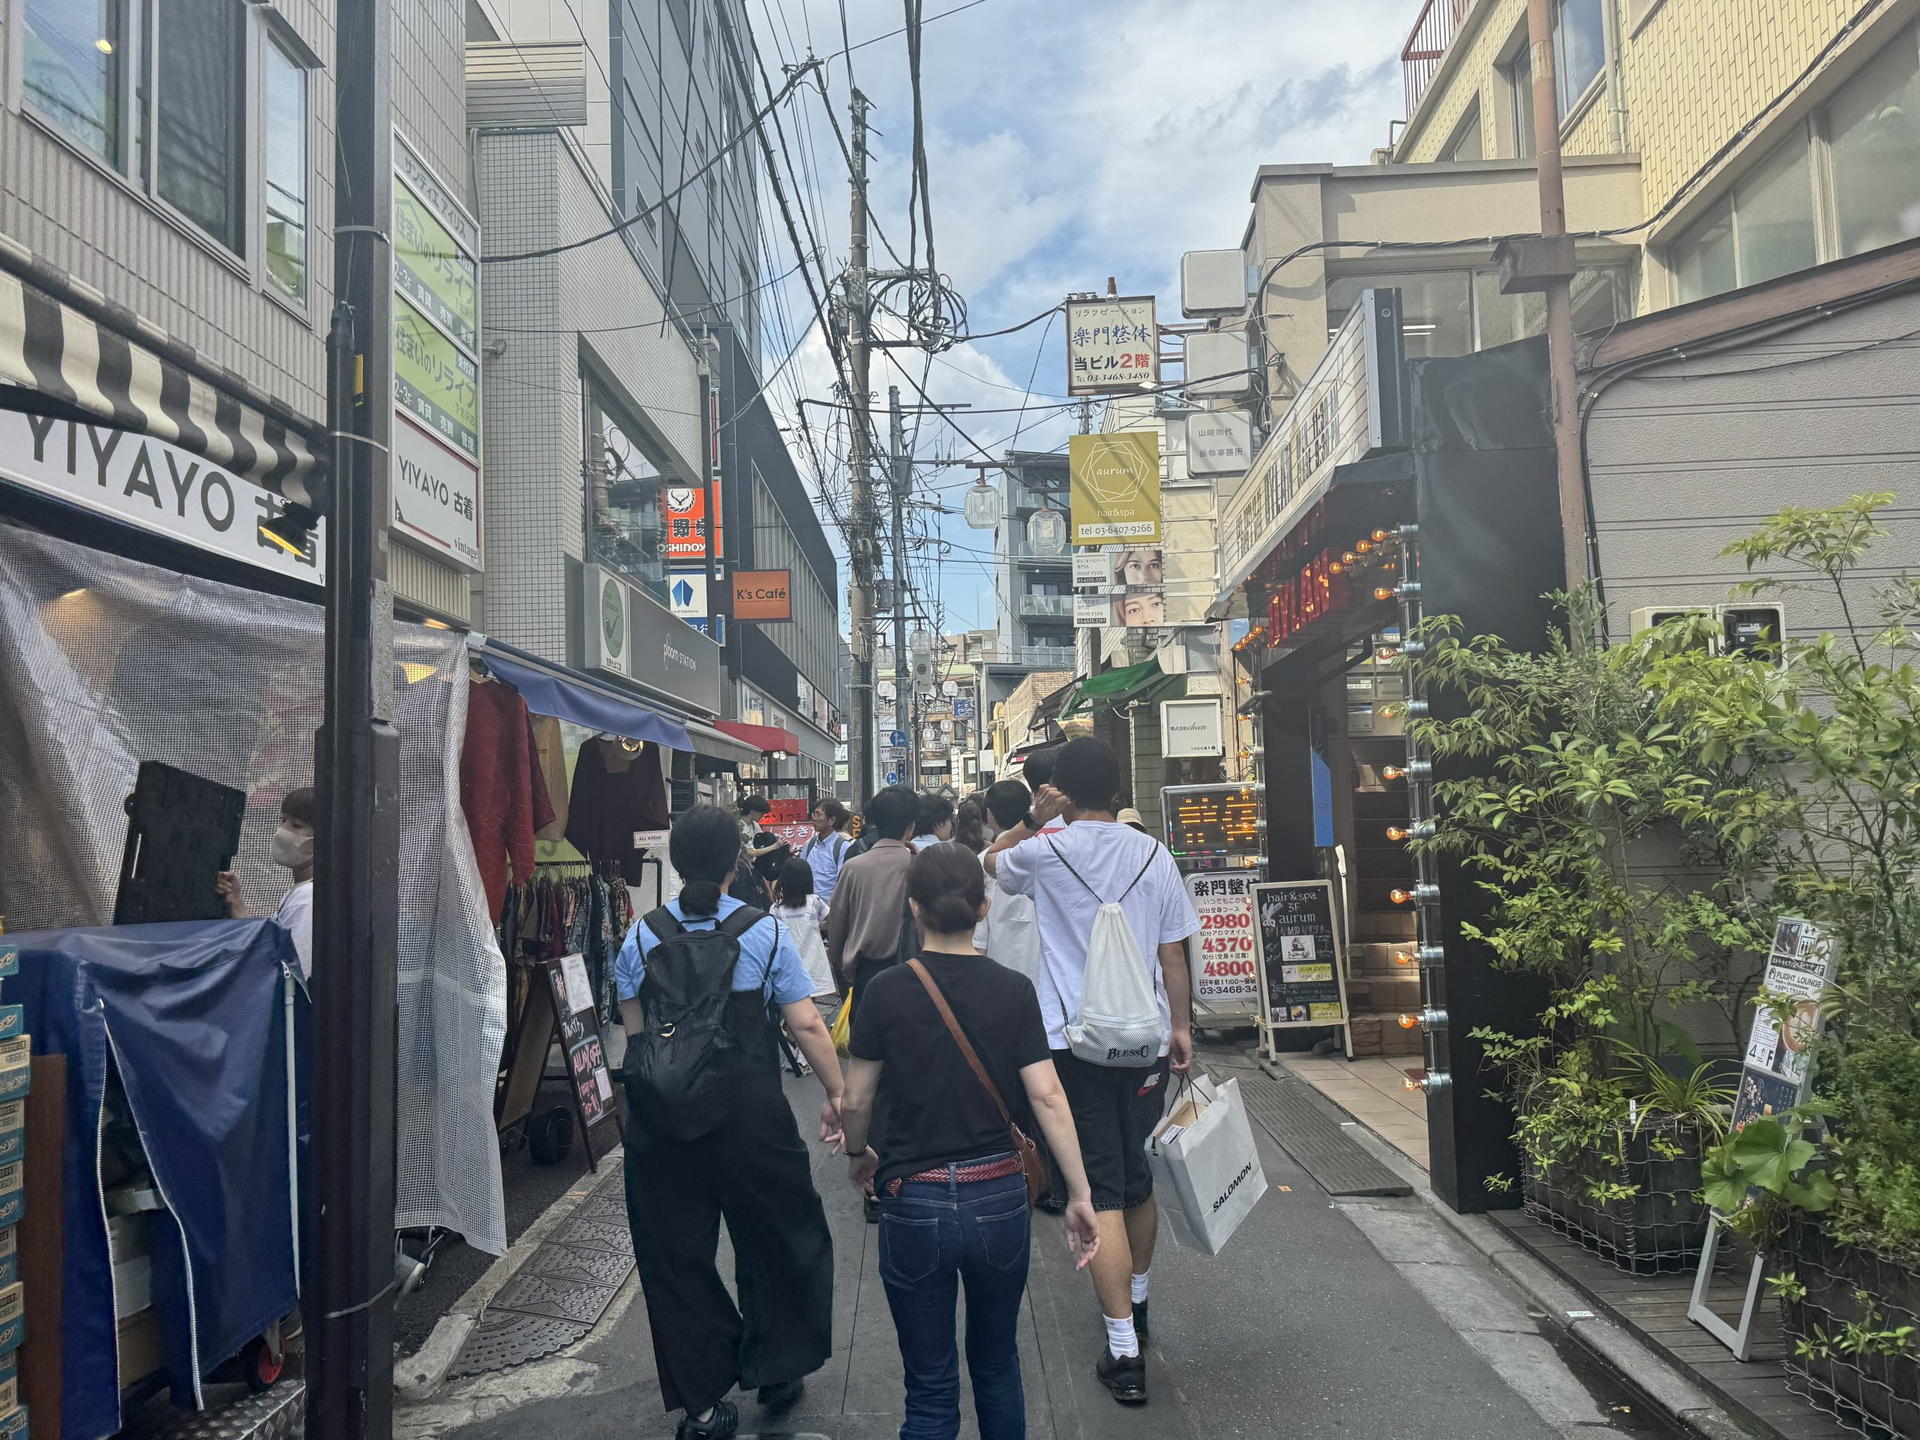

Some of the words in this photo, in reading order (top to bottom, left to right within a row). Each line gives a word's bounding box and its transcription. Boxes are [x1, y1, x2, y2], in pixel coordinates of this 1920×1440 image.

[1075, 307, 1145, 317] リラクゼーション
[1072, 324, 1152, 348] 楽門整体
[395, 326, 477, 410] 住まいのリライフ
[1074, 353, 1150, 371] 当ビル2階
[1096, 466, 1133, 476] aurum
[27, 414, 235, 532] YIYAYO
[255, 493, 319, 568] 古
[398, 455, 449, 506] YIYAYO
[453, 490, 473, 522] 古着
[1097, 508, 1135, 518] hair&spa
[1081, 527, 1092, 535] tel
[1094, 524, 1153, 537] 03-6407-9266
[736, 589, 753, 600] K's
[755, 588, 786, 600] Café
[1267, 891, 1317, 903] hair&spa
[1288, 902, 1300, 912] 3F
[1200, 913, 1250, 930] 2980
[1279, 913, 1316, 923] aurum
[1202, 936, 1252, 953] 4370
[1204, 960, 1254, 977] 4800
[1776, 971, 1796, 981] FLIGHT
[1796, 976, 1822, 988] LOUNGE
[1212, 1162, 1252, 1213] SALOMON
